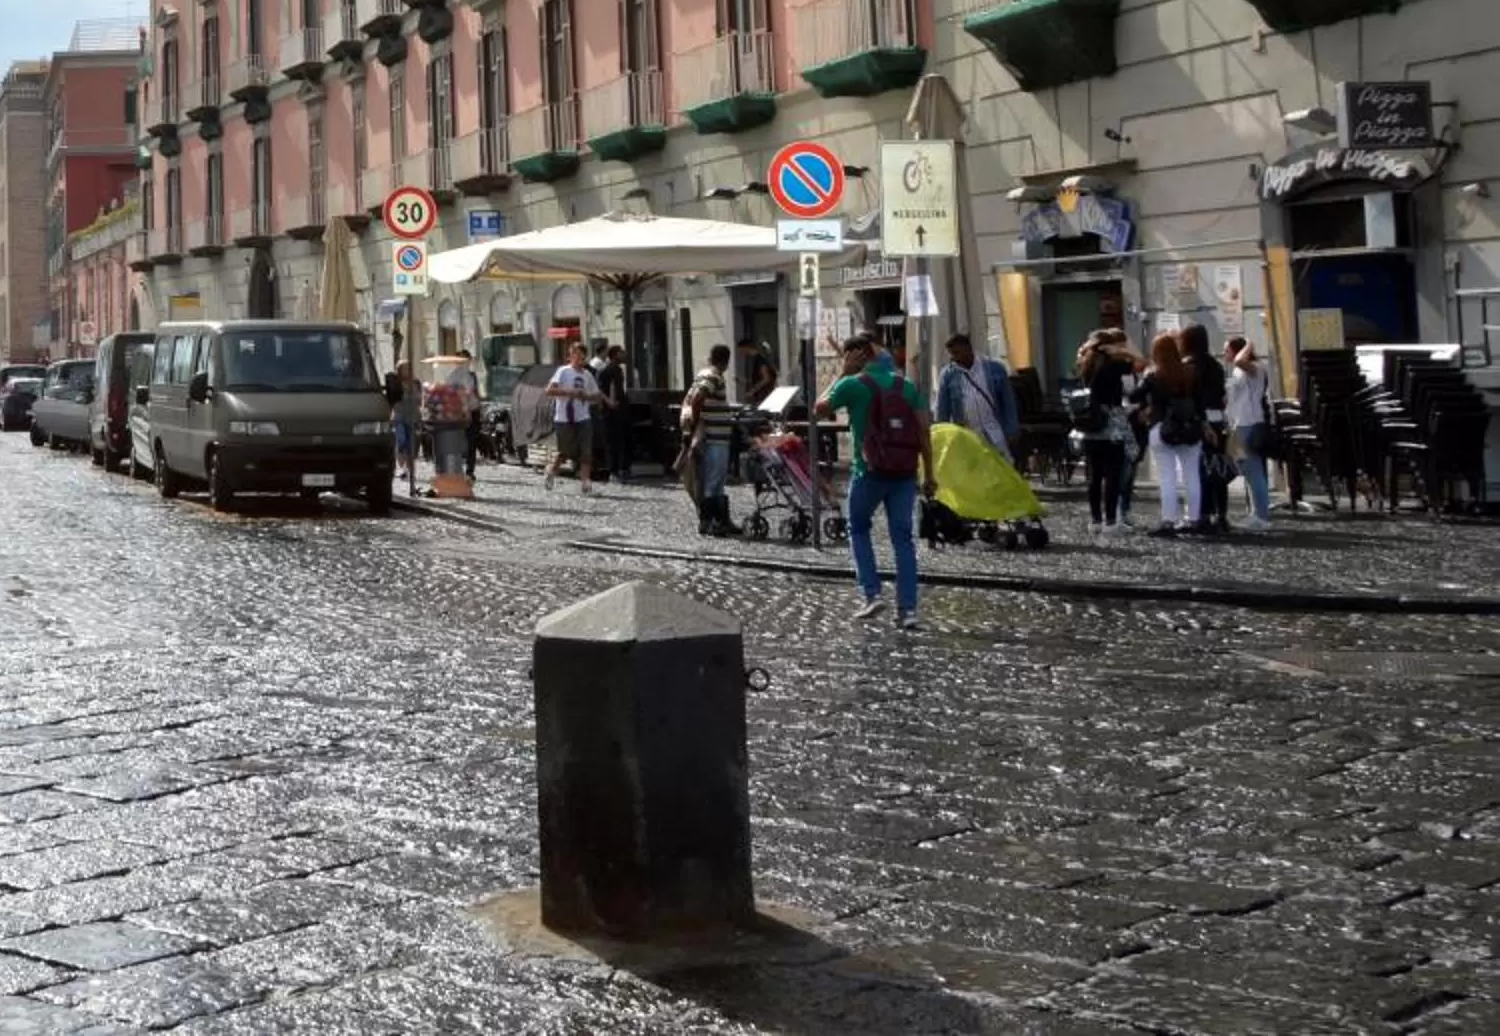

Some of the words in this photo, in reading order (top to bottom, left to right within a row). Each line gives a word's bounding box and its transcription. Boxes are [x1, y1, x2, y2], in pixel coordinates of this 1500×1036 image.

[1357, 86, 1418, 110] Pizza
[1353, 121, 1428, 144] Piazza
[396, 202, 423, 224] 30
